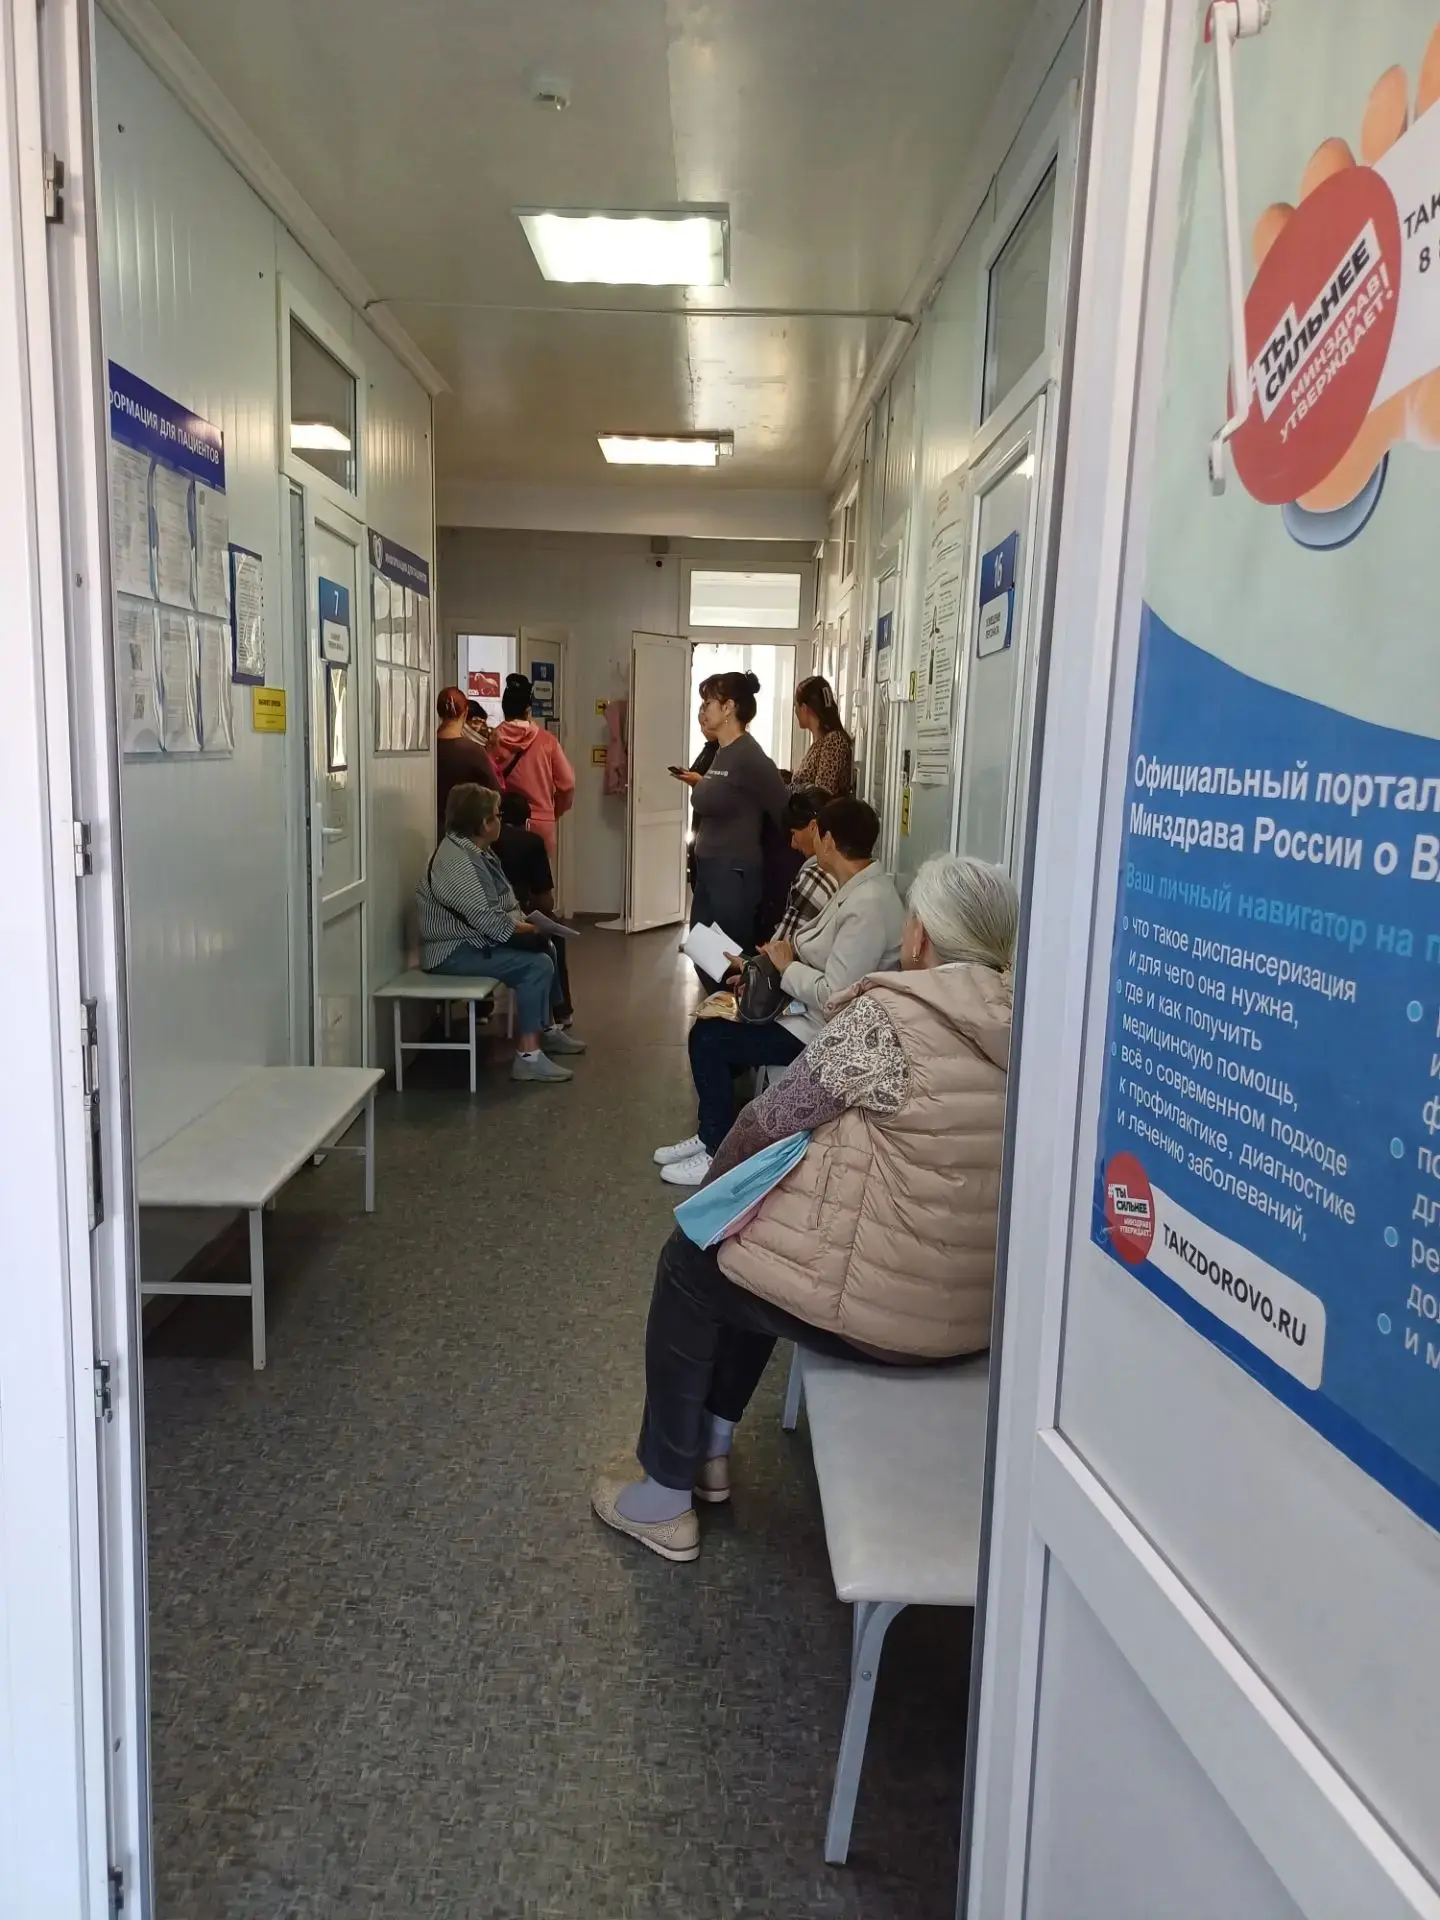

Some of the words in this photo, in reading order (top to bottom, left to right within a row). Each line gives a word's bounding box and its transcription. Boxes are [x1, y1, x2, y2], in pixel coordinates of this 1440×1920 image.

[1419, 246, 1431, 274] 8
[1265, 238, 1371, 402] СИЛЬНЕЕ
[160, 417, 176, 441] ДЛЯ
[177, 428, 220, 465] ПАЦИЕНТОВ
[333, 589, 340, 617] 7
[1134, 754, 1309, 801] Официальный
[1315, 772, 1440, 817] портал
[1130, 802, 1244, 853] Минздрава
[1253, 816, 1363, 871] России
[1373, 842, 1398, 875] о
[1410, 833, 1440, 883] В
[1126, 862, 1155, 895] Ваш
[1158, 876, 1232, 914] личный
[1238, 894, 1367, 953] навигатор
[1376, 923, 1413, 957] на
[1128, 949, 1137, 967] и
[1137, 953, 1162, 977] для
[1164, 962, 1195, 990] чего
[1198, 975, 1226, 1002] она
[1231, 985, 1299, 1029] нужна,
[1132, 917, 1150, 939] что
[1153, 923, 1189, 952] такое
[1191, 937, 1357, 1004] диспансеризация
[1124, 981, 1144, 1005] где
[1146, 990, 1155, 1010] и
[1158, 995, 1182, 1021] как
[1185, 1005, 1262, 1051] получить
[1122, 1013, 1213, 1070] медицинскую
[1217, 1057, 1298, 1113] помощь,
[1119, 1076, 1126, 1094] к
[1238, 1143, 1356, 1225] диагностике
[1121, 1044, 1142, 1070] всё
[1144, 1058, 1153, 1076] о
[1156, 1064, 1266, 1133] современном
[1271, 1117, 1348, 1177] подходе
[1115, 1200, 1148, 1214] СИЛЬНЕЕ
[1117, 1107, 1126, 1127] и
[1128, 1114, 1185, 1164] лечению
[1187, 1152, 1307, 1243] заболеваний,
[1163, 1223, 1306, 1346] TAKZDOROVO.RU
[1404, 1327, 1419, 1356] и
